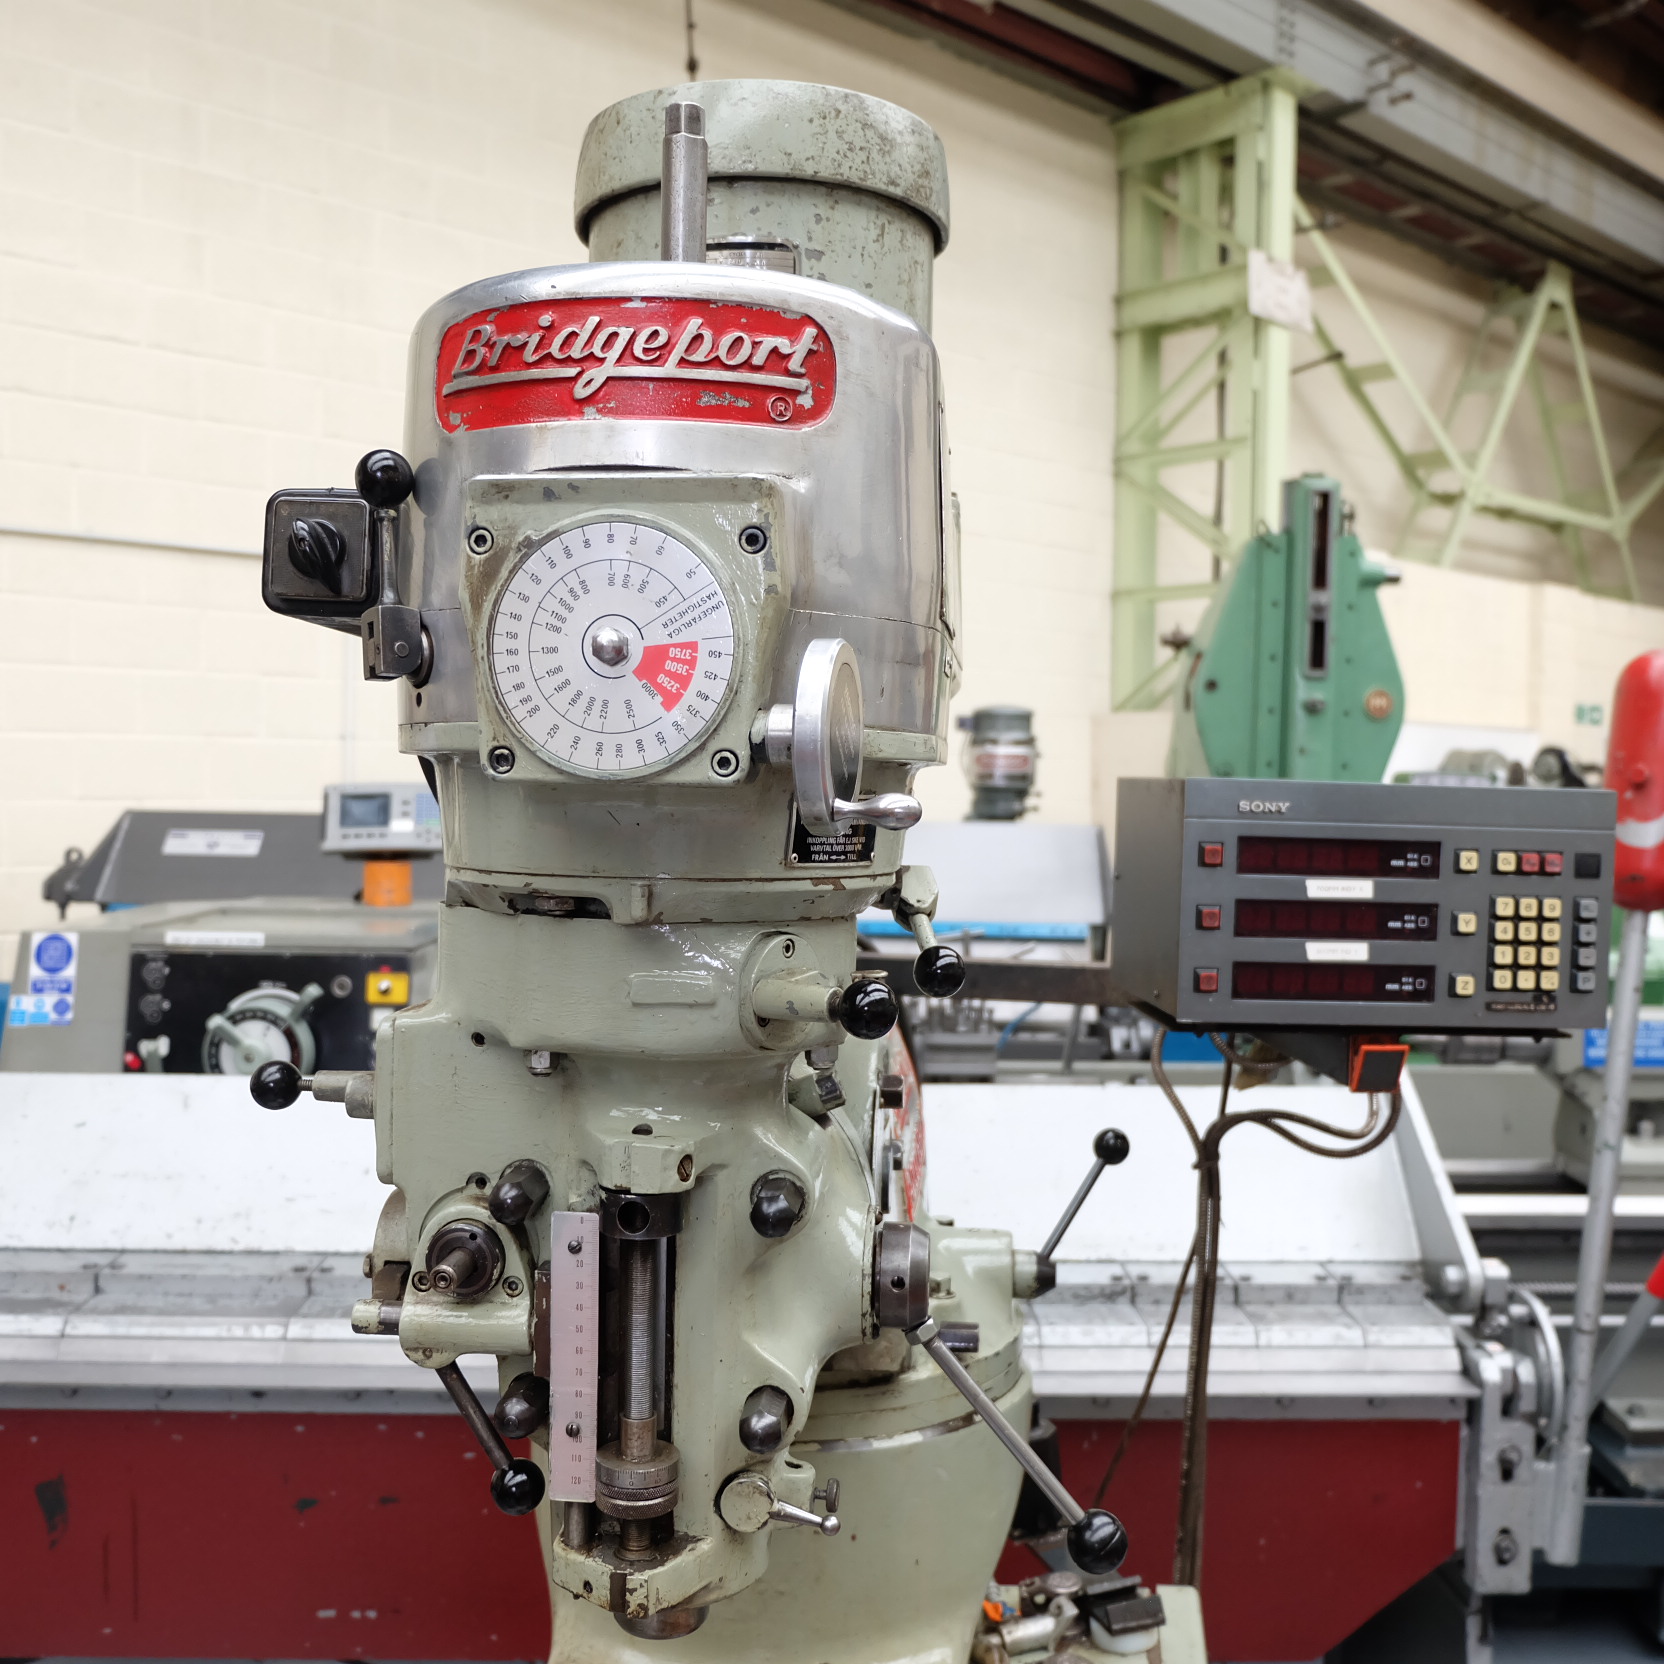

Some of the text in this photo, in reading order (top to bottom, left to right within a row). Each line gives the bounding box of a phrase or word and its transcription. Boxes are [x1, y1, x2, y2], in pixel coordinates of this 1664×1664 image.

[452, 315, 819, 399] Bridgeport
[582, 538, 591, 548] 90
[606, 534, 614, 543] 80
[630, 535, 638, 545] 70
[562, 545, 573, 560] 100
[656, 546, 665, 556] 60
[545, 556, 557, 570] 110
[685, 568, 697, 579] 50
[529, 573, 542, 586] 120
[622, 574, 631, 589] 600
[578, 580, 590, 595] 800
[637, 579, 649, 594] 500
[517, 592, 530, 604] 130
[567, 587, 580, 601] 900
[558, 597, 574, 614] 1000
[655, 595, 668, 608] 450
[661, 590, 718, 629] HASTIGHETER
[509, 612, 522, 622] 140
[550, 610, 567, 624] 1100
[667, 600, 725, 639] UNGEFÄRLIGA
[545, 622, 562, 634] 1200
[505, 632, 518, 640] 150
[505, 648, 519, 656] 160
[541, 646, 559, 654] 1300
[669, 647, 692, 659] 3750
[708, 650, 723, 658] 450
[506, 664, 520, 674] 170
[546, 665, 564, 678] 1500
[665, 660, 689, 675] 3500
[704, 670, 718, 680] 425
[512, 682, 526, 692] 180
[553, 678, 571, 694] 1600
[657, 674, 680, 693] 3250
[642, 682, 659, 700] 3000
[696, 690, 710, 702] 400
[519, 695, 533, 706] 190
[568, 689, 584, 708] 1800
[526, 704, 541, 718] 200
[583, 696, 597, 717] 2000
[599, 699, 609, 720] 2200
[624, 699, 635, 719] 2500
[686, 704, 700, 718] 375
[546, 724, 560, 738] 220
[672, 720, 684, 734] 350
[570, 735, 581, 751] 240
[655, 731, 667, 747] 325
[595, 742, 604, 757] 260
[636, 739, 645, 754] 300
[1238, 801, 1290, 812] SONY
[1465, 857, 1472, 865] X
[1502, 902, 1510, 911] 7
[1525, 903, 1532, 912] 8
[1548, 903, 1556, 912] 9
[1463, 918, 1471, 927] Y
[1500, 926, 1508, 935] 4
[1524, 926, 1532, 935] 5
[1547, 927, 1555, 936] 6
[1524, 952, 1531, 960] 2
[1547, 952, 1554, 961] 3
[1461, 981, 1469, 990] Z
[580, 1216, 584, 1224] 0
[576, 1260, 583, 1268] 20
[576, 1281, 583, 1289] 30
[576, 1325, 583, 1333] 50
[576, 1346, 583, 1354] 60
[576, 1368, 582, 1376] 70
[575, 1390, 582, 1398] 80
[575, 1411, 582, 1419] 90
[573, 1435, 582, 1443] 100
[572, 1454, 581, 1462] 110
[571, 1476, 581, 1484] 120
